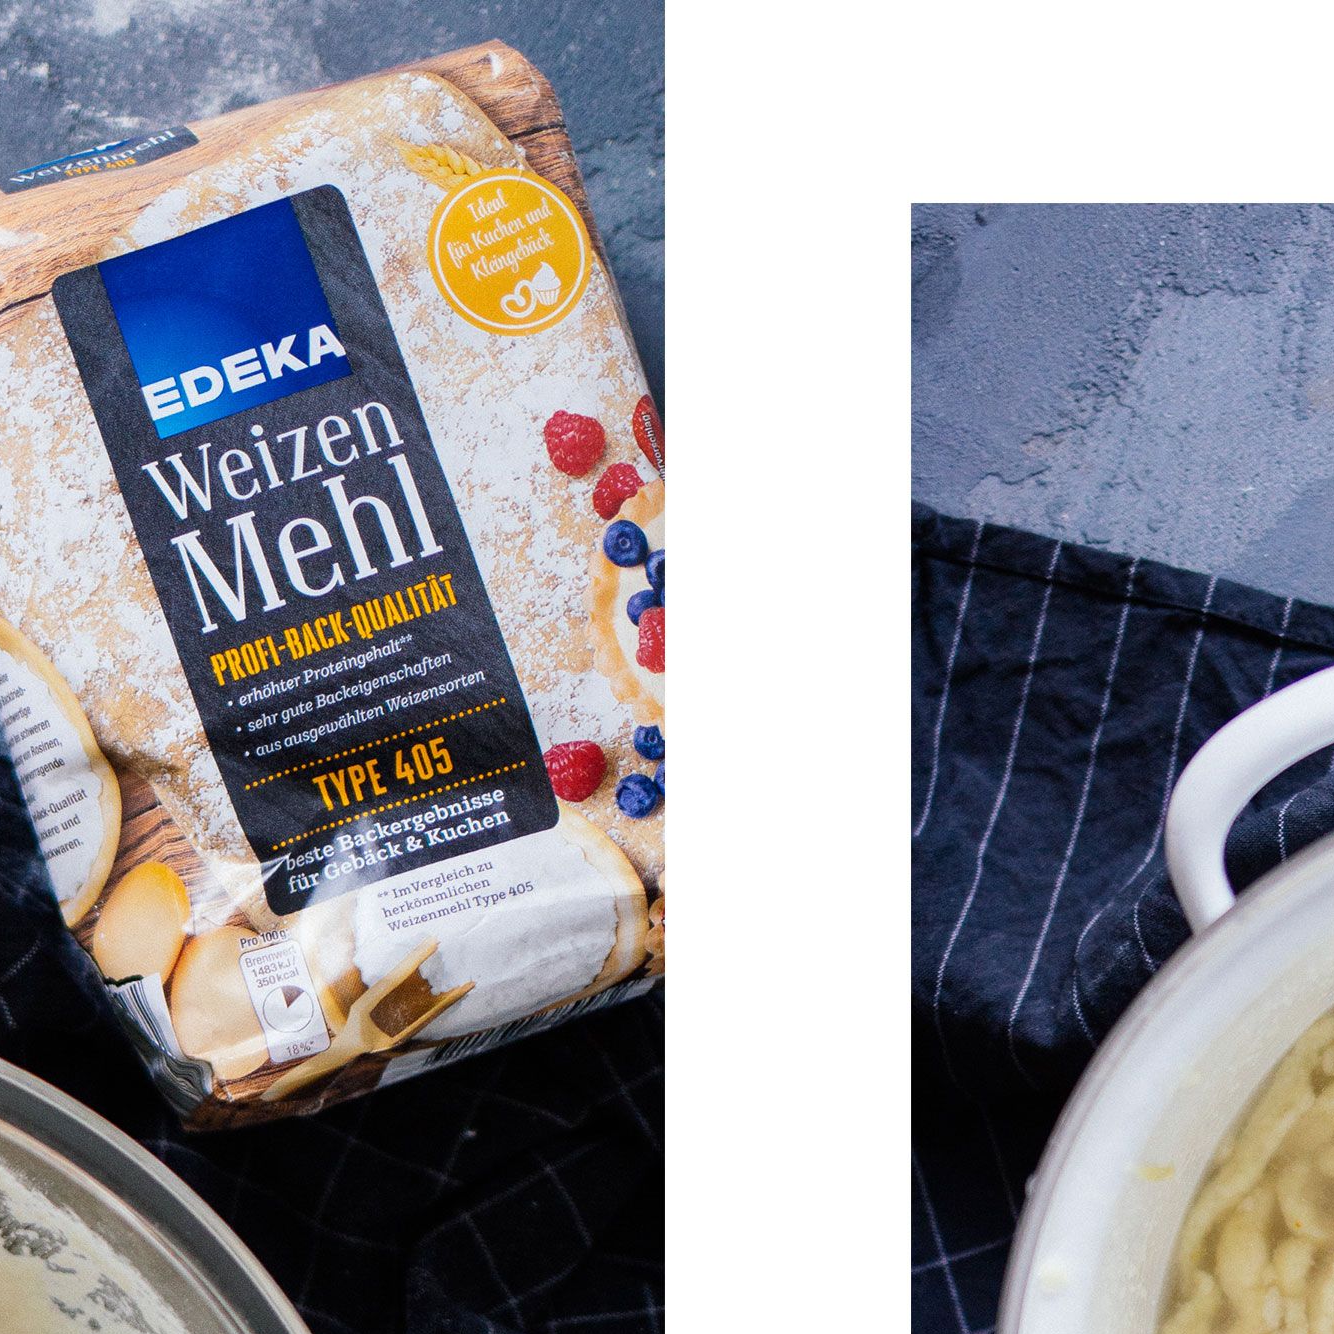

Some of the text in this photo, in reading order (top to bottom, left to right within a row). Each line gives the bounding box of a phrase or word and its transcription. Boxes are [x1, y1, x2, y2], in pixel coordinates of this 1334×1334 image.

[9, 130, 176, 183] Weizenmehl
[446, 197, 554, 269] für Kuchen und
[467, 188, 508, 222] Ideal
[471, 227, 555, 281] Kleingebäck
[142, 324, 346, 421] EDEKA
[142, 400, 405, 520] Weizen
[171, 455, 443, 634] Mehl
[210, 573, 458, 687] PROFI-BACK-QUALITÄT
[239, 674, 301, 707] erhöhter
[248, 651, 453, 733] sehr gute Backeigenschaften
[256, 670, 486, 758] aus ausgewählten Weizensorten
[312, 736, 454, 812] TYPE 405
[61, 814, 81, 831] und
[285, 788, 505, 872] beste Backergebnisse
[288, 810, 511, 895] für Gebäck & Kuchen
[382, 876, 491, 918] herkömmlichen
[476, 860, 493, 872] zu
[387, 881, 534, 932] Weizenmehl Type 405
[240, 936, 258, 949] Pro
[245, 946, 297, 968] Brennwert
